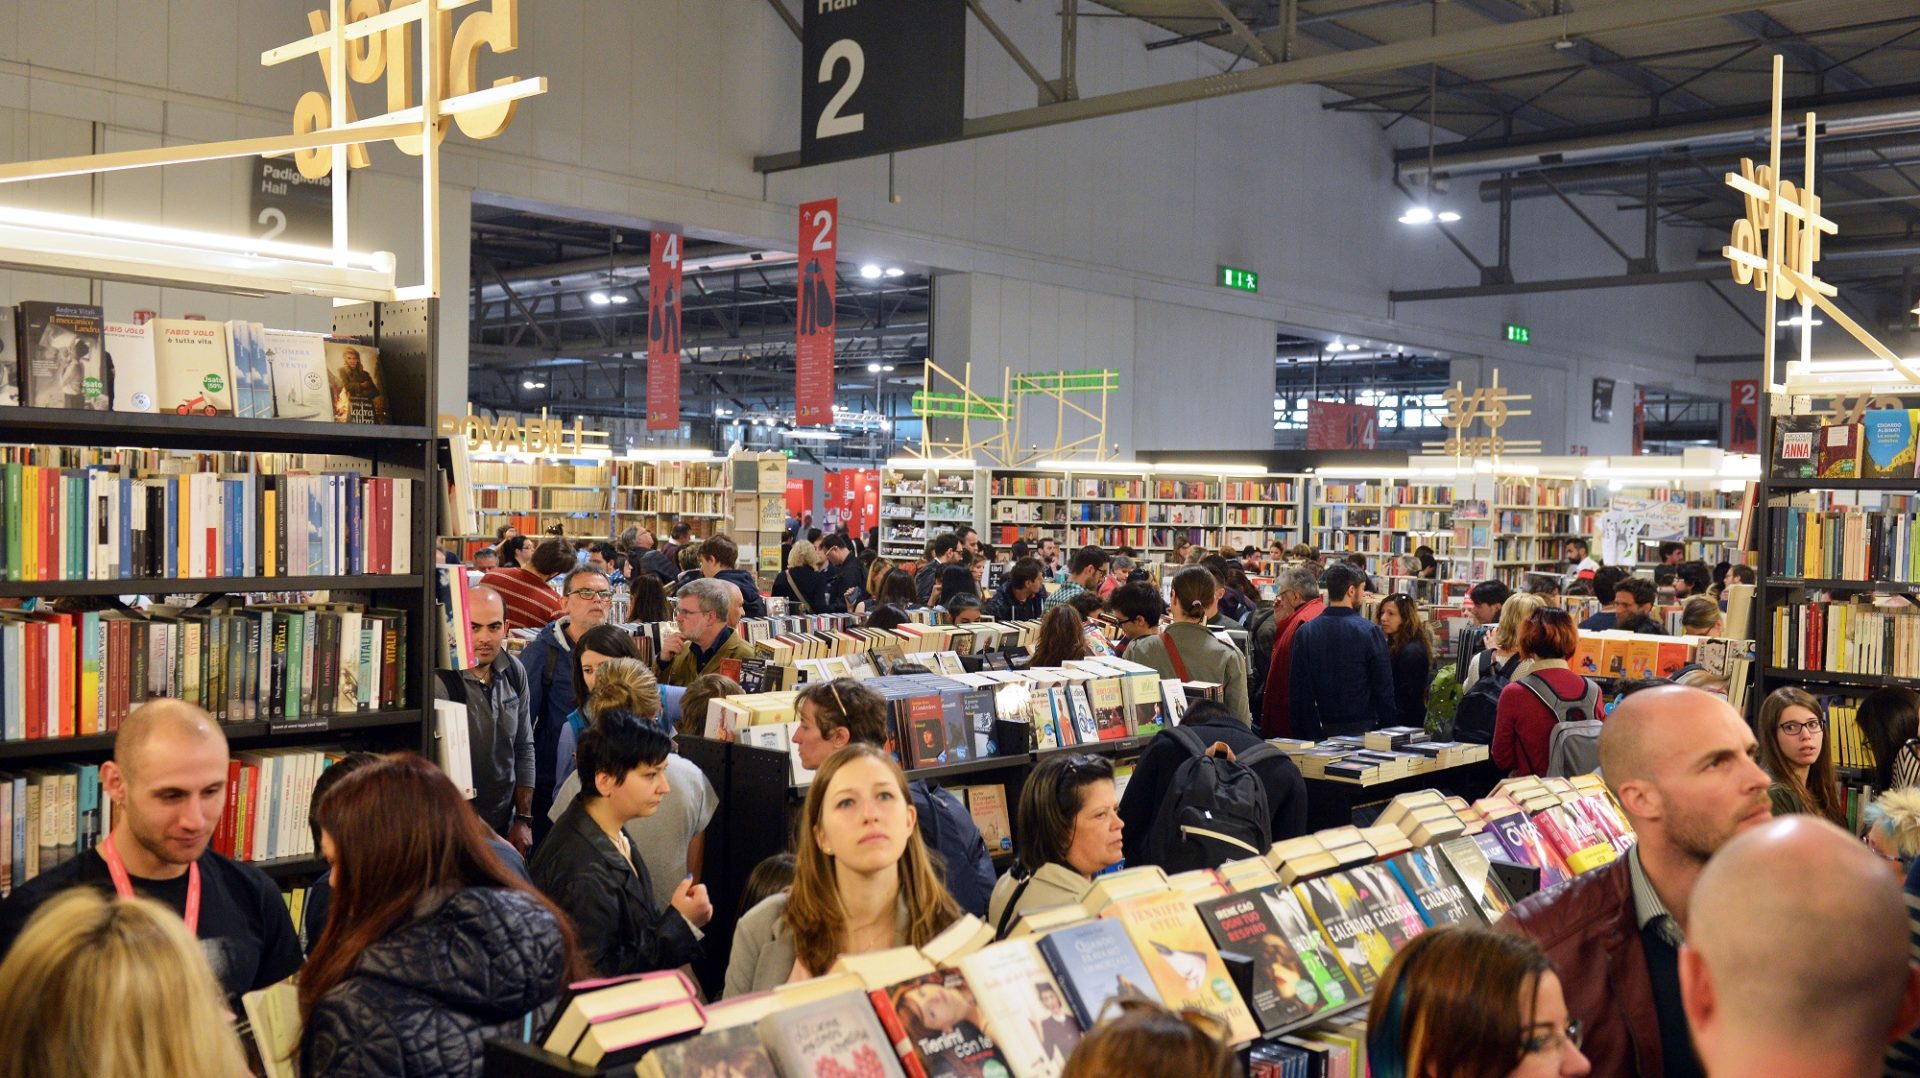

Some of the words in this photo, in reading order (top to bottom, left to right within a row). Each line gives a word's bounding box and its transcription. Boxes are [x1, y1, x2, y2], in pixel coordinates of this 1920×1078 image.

[818, 0, 858, 15] Ha
[816, 38, 865, 139] 2
[261, 180, 287, 196] Hall
[257, 207, 287, 241] 2
[812, 210, 833, 252] 2
[662, 234, 680, 269] 4
[165, 328, 190, 336] FABIO
[193, 329, 215, 337] VOLO
[1442, 387, 1508, 428] 3/5
[1741, 384, 1756, 405] 2
[1362, 418, 1376, 449] 4
[1784, 443, 1809, 457] ANNA
[158, 628, 166, 657] VITALI
[190, 627, 199, 657] VITALI
[251, 625, 259, 653] VITALI
[278, 624, 286, 653] VITALI
[361, 636, 371, 664] VITALI
[386, 635, 396, 664] VITALI
[1506, 822, 1543, 847] OVER
[1215, 904, 1239, 921] IRENE
[1237, 901, 1255, 915] CAO
[1420, 885, 1465, 911] CALENDAR
[1131, 902, 1187, 924] JENNIFER
[1242, 911, 1261, 927] TUO
[1374, 901, 1418, 928] CALENDAR
[1327, 914, 1376, 943] CALENDAR
[953, 1040, 977, 1059] con
[977, 1036, 993, 1053] te
